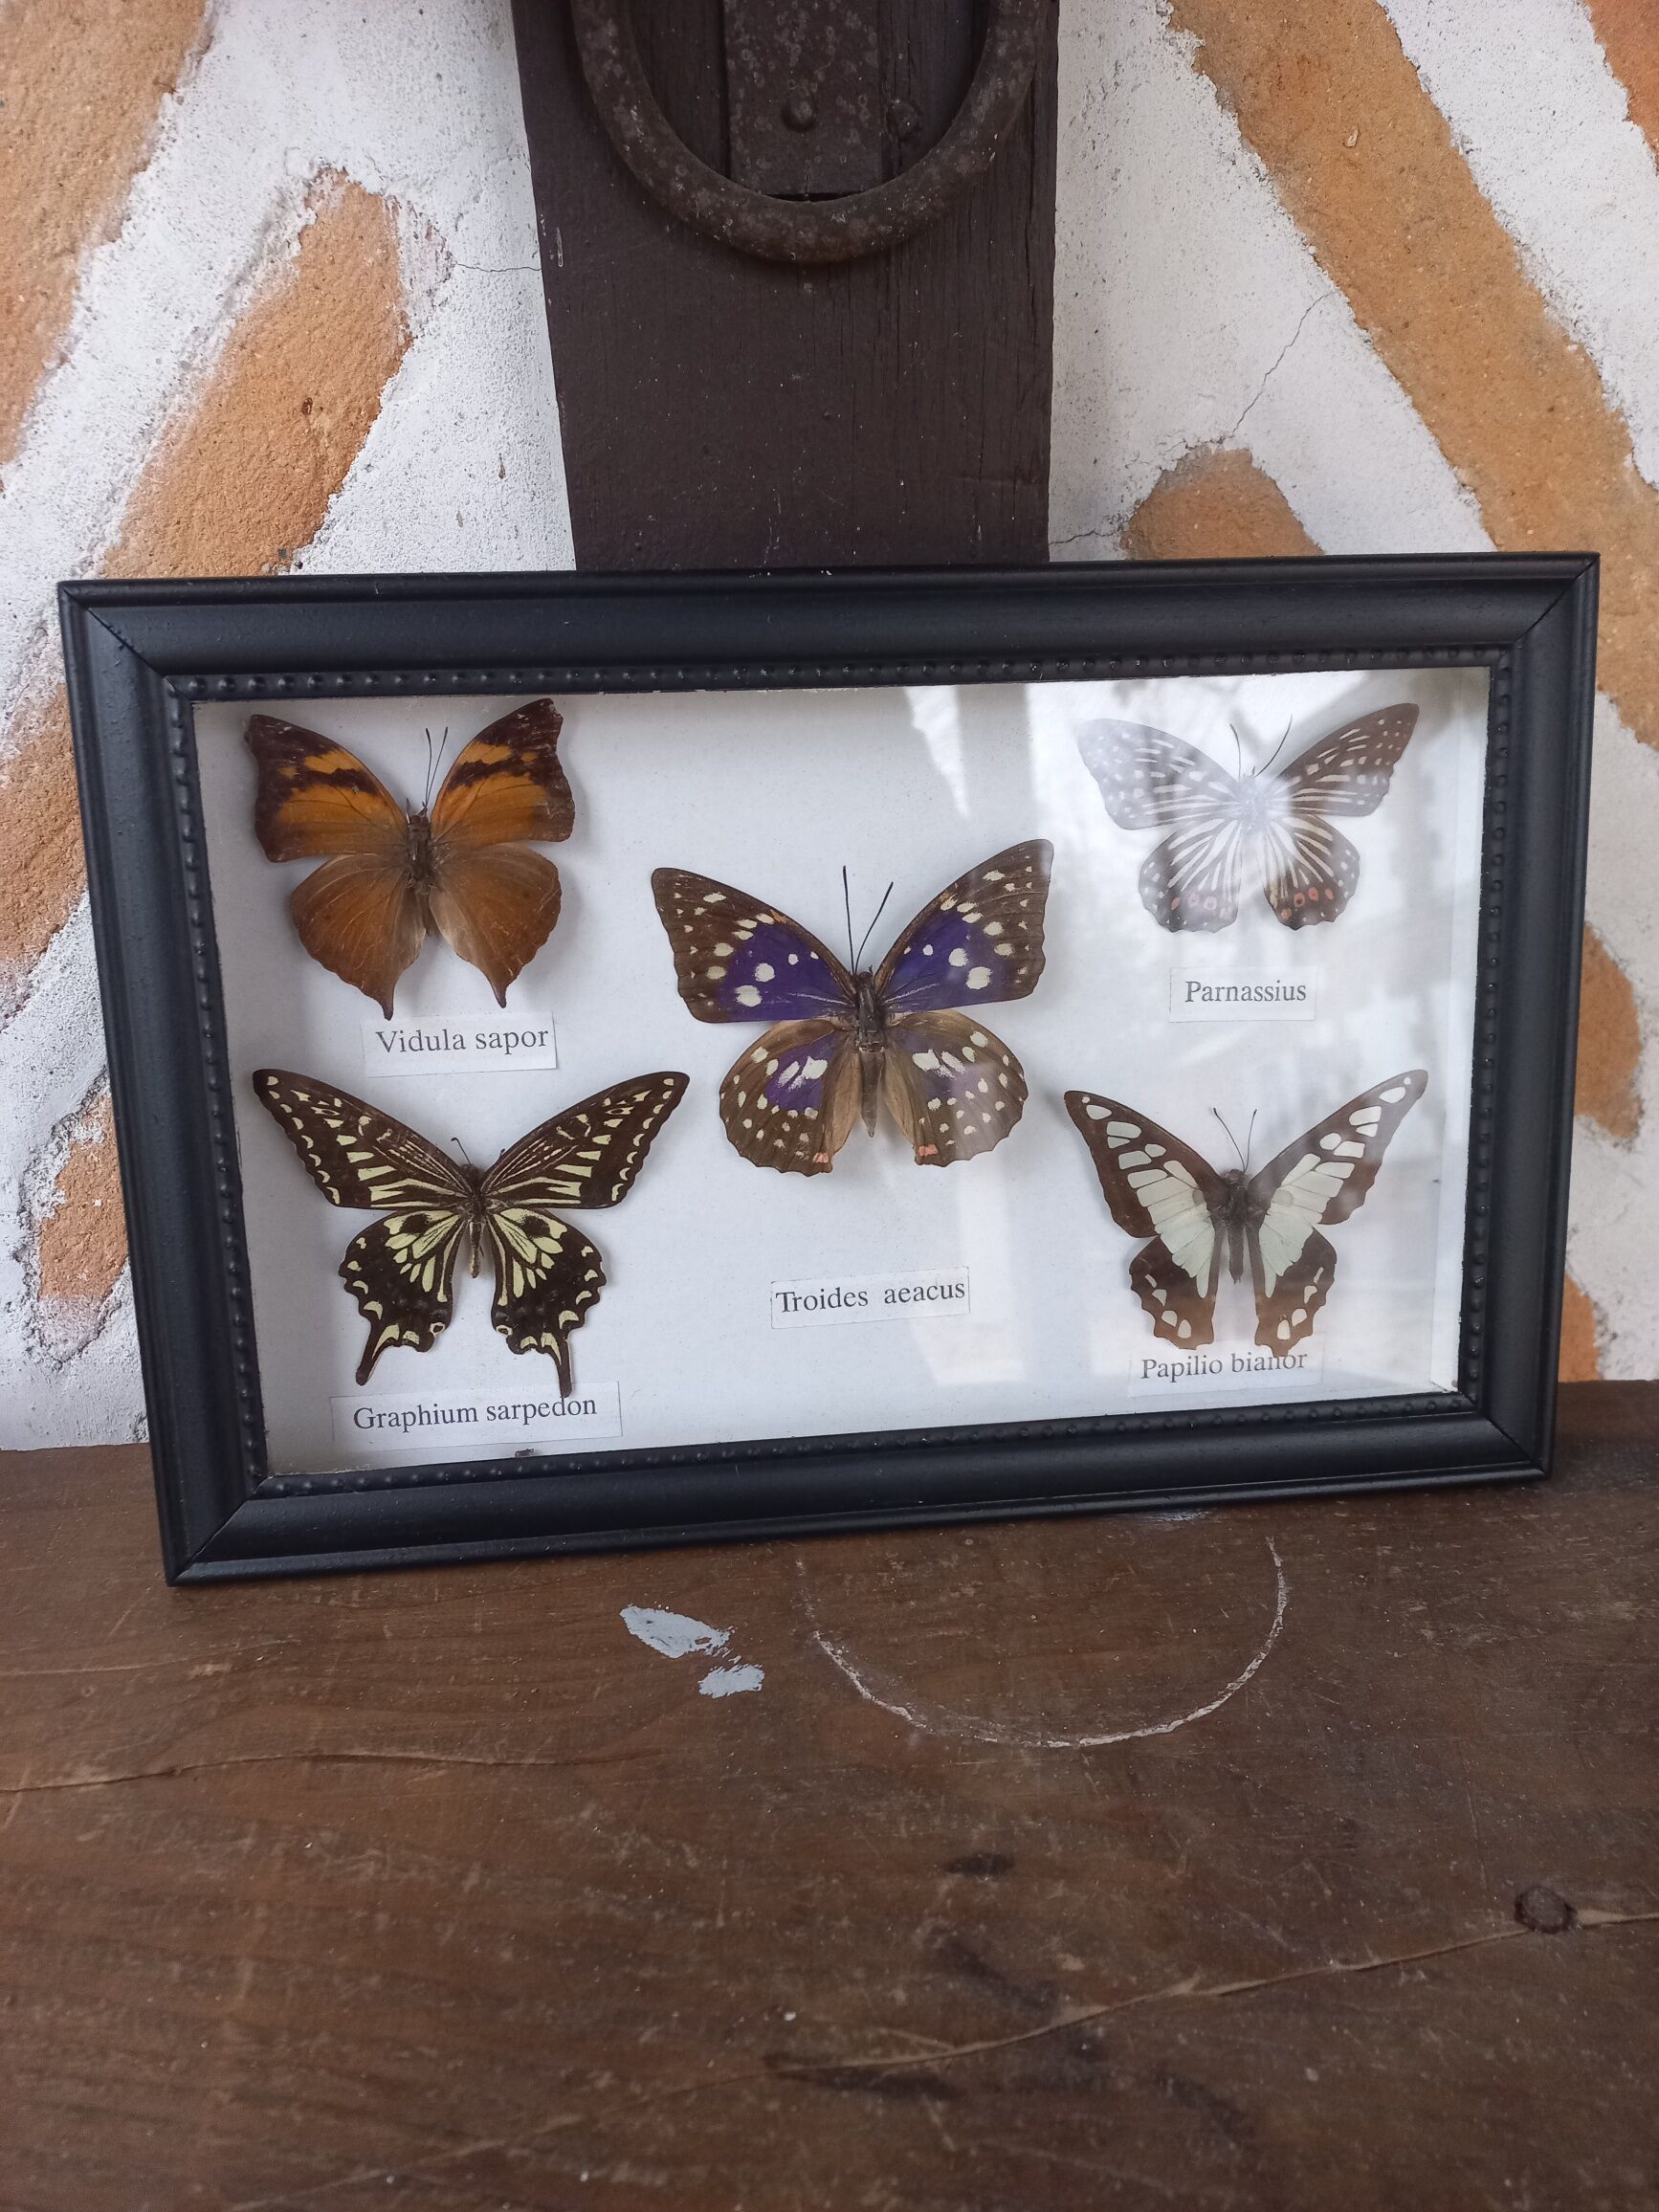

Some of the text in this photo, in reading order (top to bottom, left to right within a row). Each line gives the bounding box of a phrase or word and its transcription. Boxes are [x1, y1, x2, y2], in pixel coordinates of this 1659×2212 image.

[1184, 979, 1307, 1003] Parnassius
[375, 1029, 548, 1055] Vidula sapor
[775, 1282, 965, 1313] Troides aeacus
[1139, 1352, 1308, 1383] Papilio bianor
[353, 1397, 598, 1433] Graphium sarpedon
